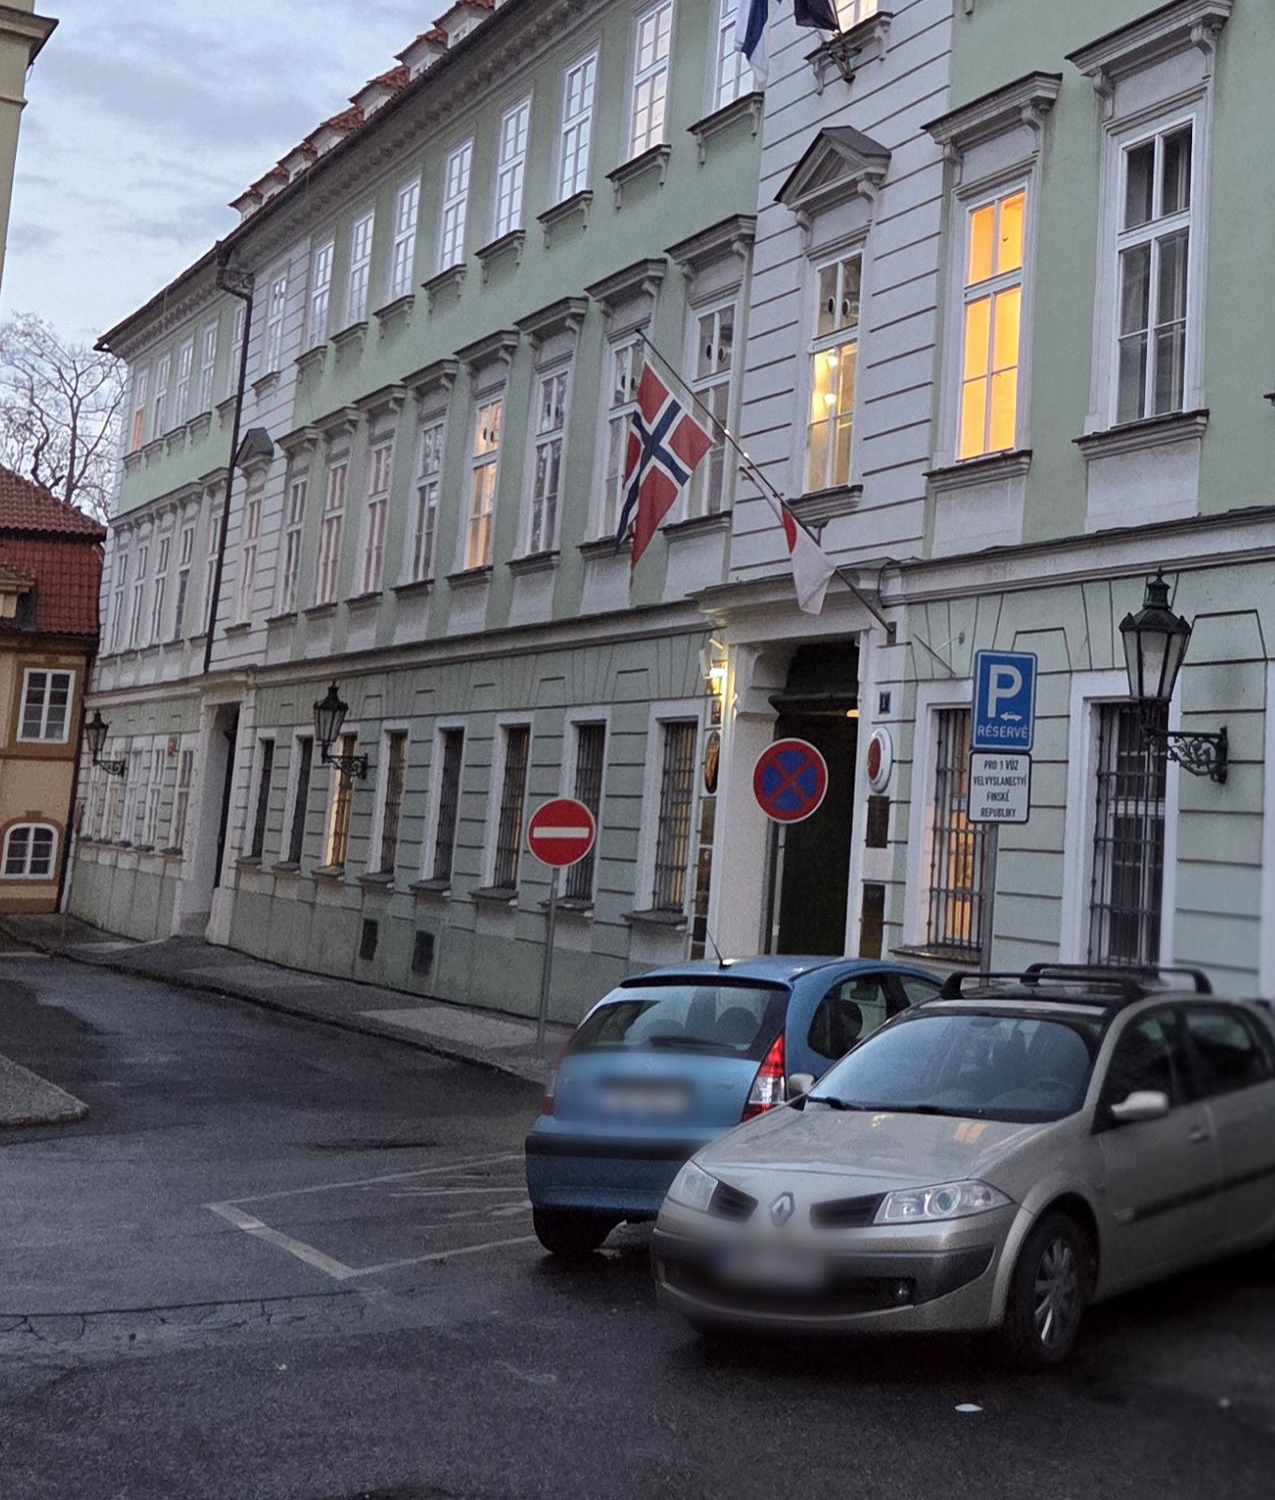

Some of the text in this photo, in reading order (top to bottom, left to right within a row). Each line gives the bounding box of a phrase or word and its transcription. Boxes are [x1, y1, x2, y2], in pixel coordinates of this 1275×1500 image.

[987, 664, 1023, 718] P
[977, 723, 1029, 739] RÉSERVÉ
[984, 759, 997, 770] PRO
[999, 760, 1004, 770] 1
[973, 774, 1027, 787] VELVYSLANECTVÍ
[986, 789, 1010, 802] FINSKÉ
[980, 808, 1017, 818] REPUBLIKY
